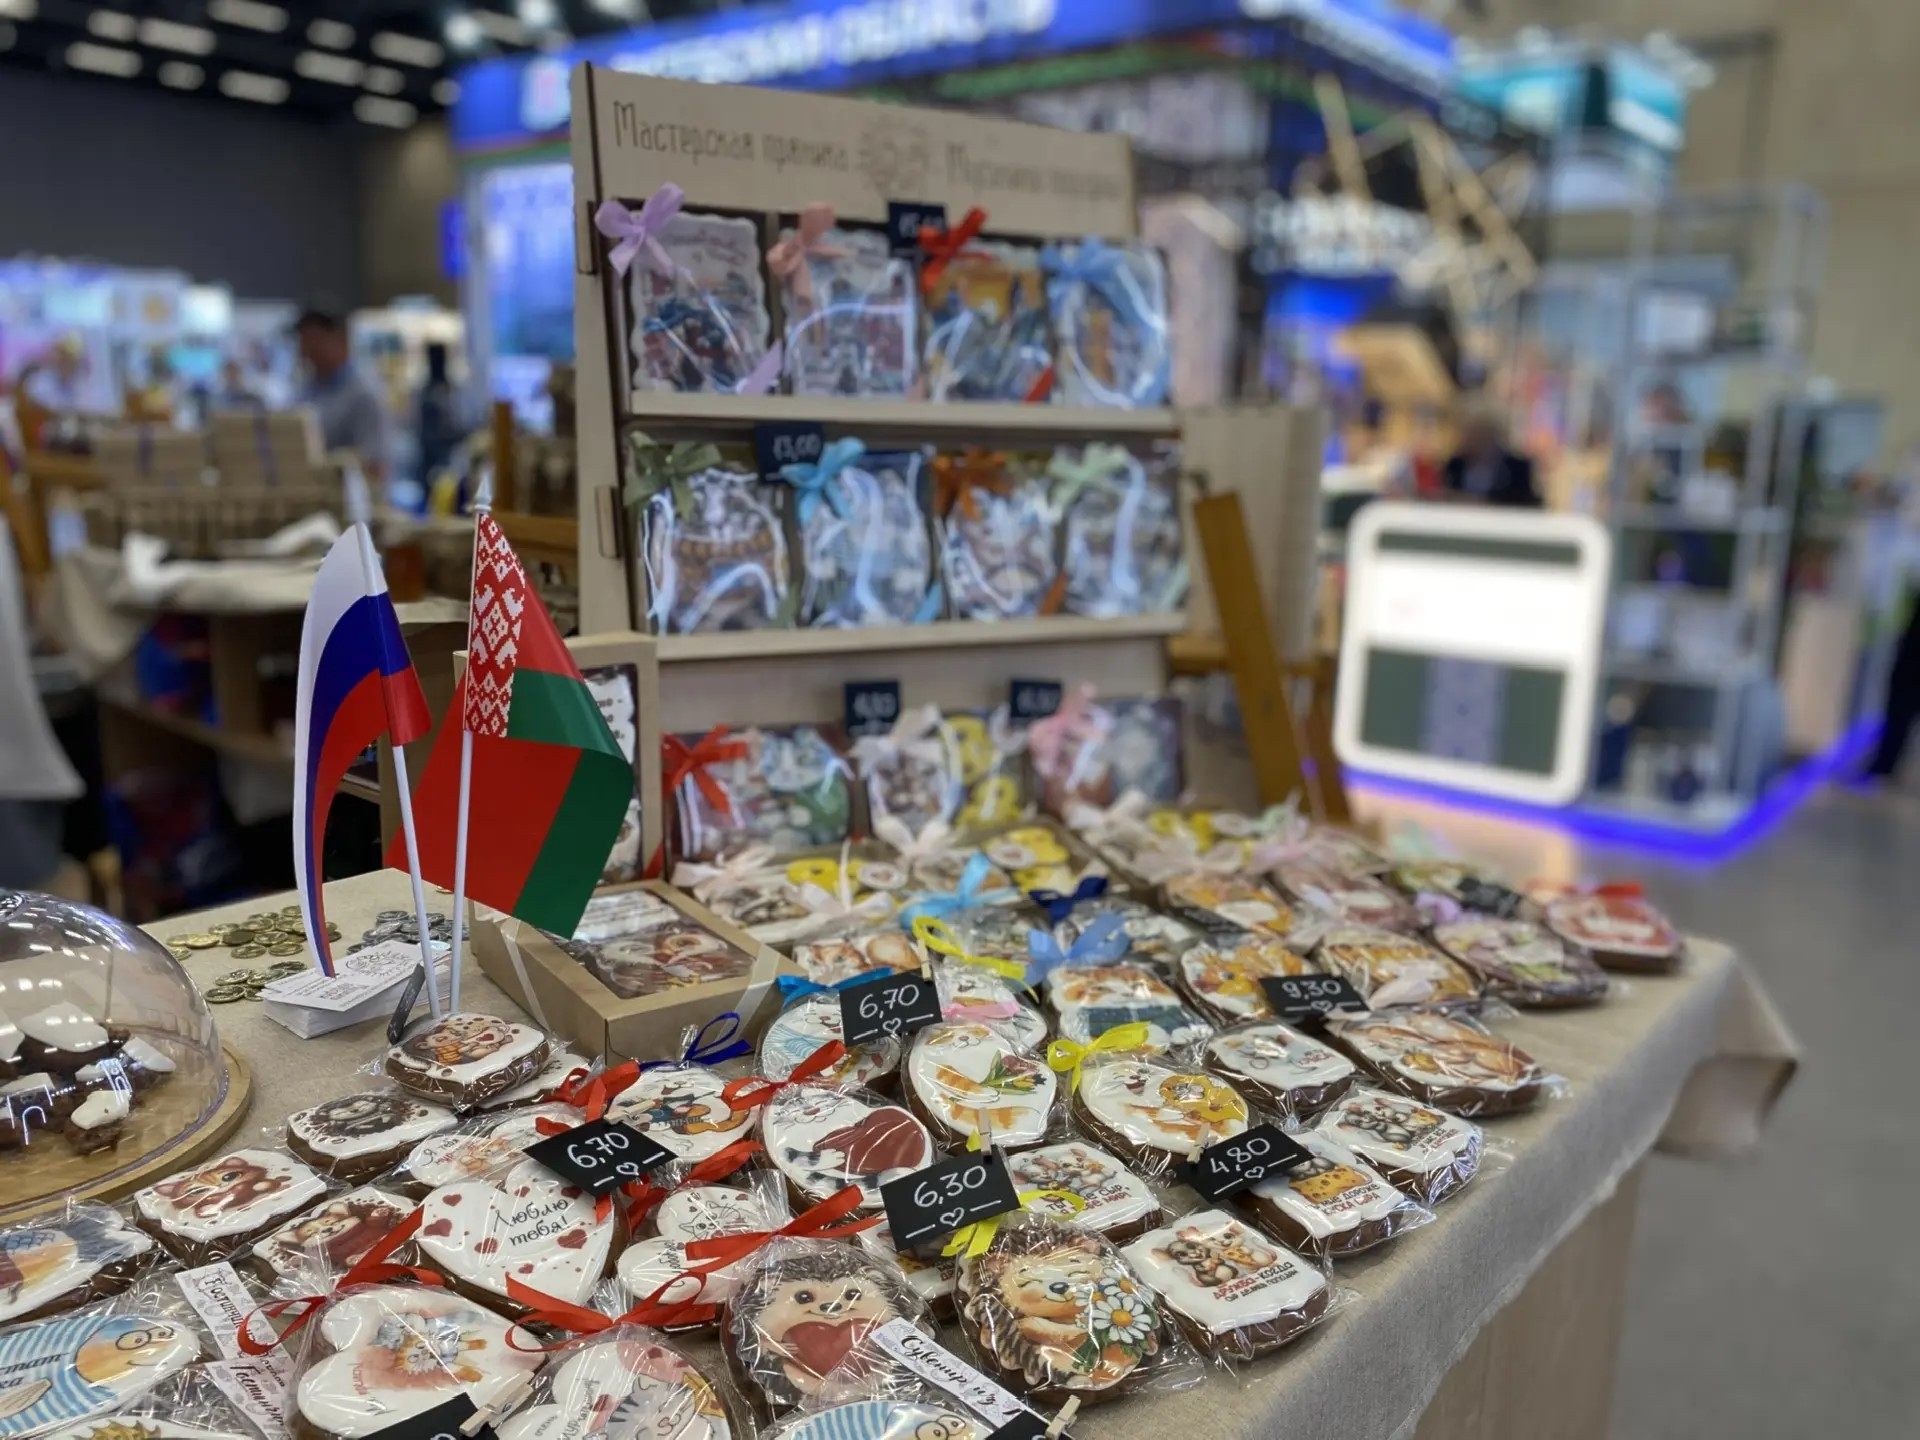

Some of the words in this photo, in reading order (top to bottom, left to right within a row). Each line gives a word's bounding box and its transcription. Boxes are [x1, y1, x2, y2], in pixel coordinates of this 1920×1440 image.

[858, 983, 920, 1019] 6,70
[1282, 979, 1342, 1000] 9,30
[566, 1131, 630, 1168] 6,70
[1210, 1138, 1271, 1175] 4,80
[914, 1165, 986, 1208] 6,30
[493, 1198, 569, 1233] Люблю
[509, 1213, 572, 1246] тебя!
[900, 1334, 968, 1384] Сувенир
